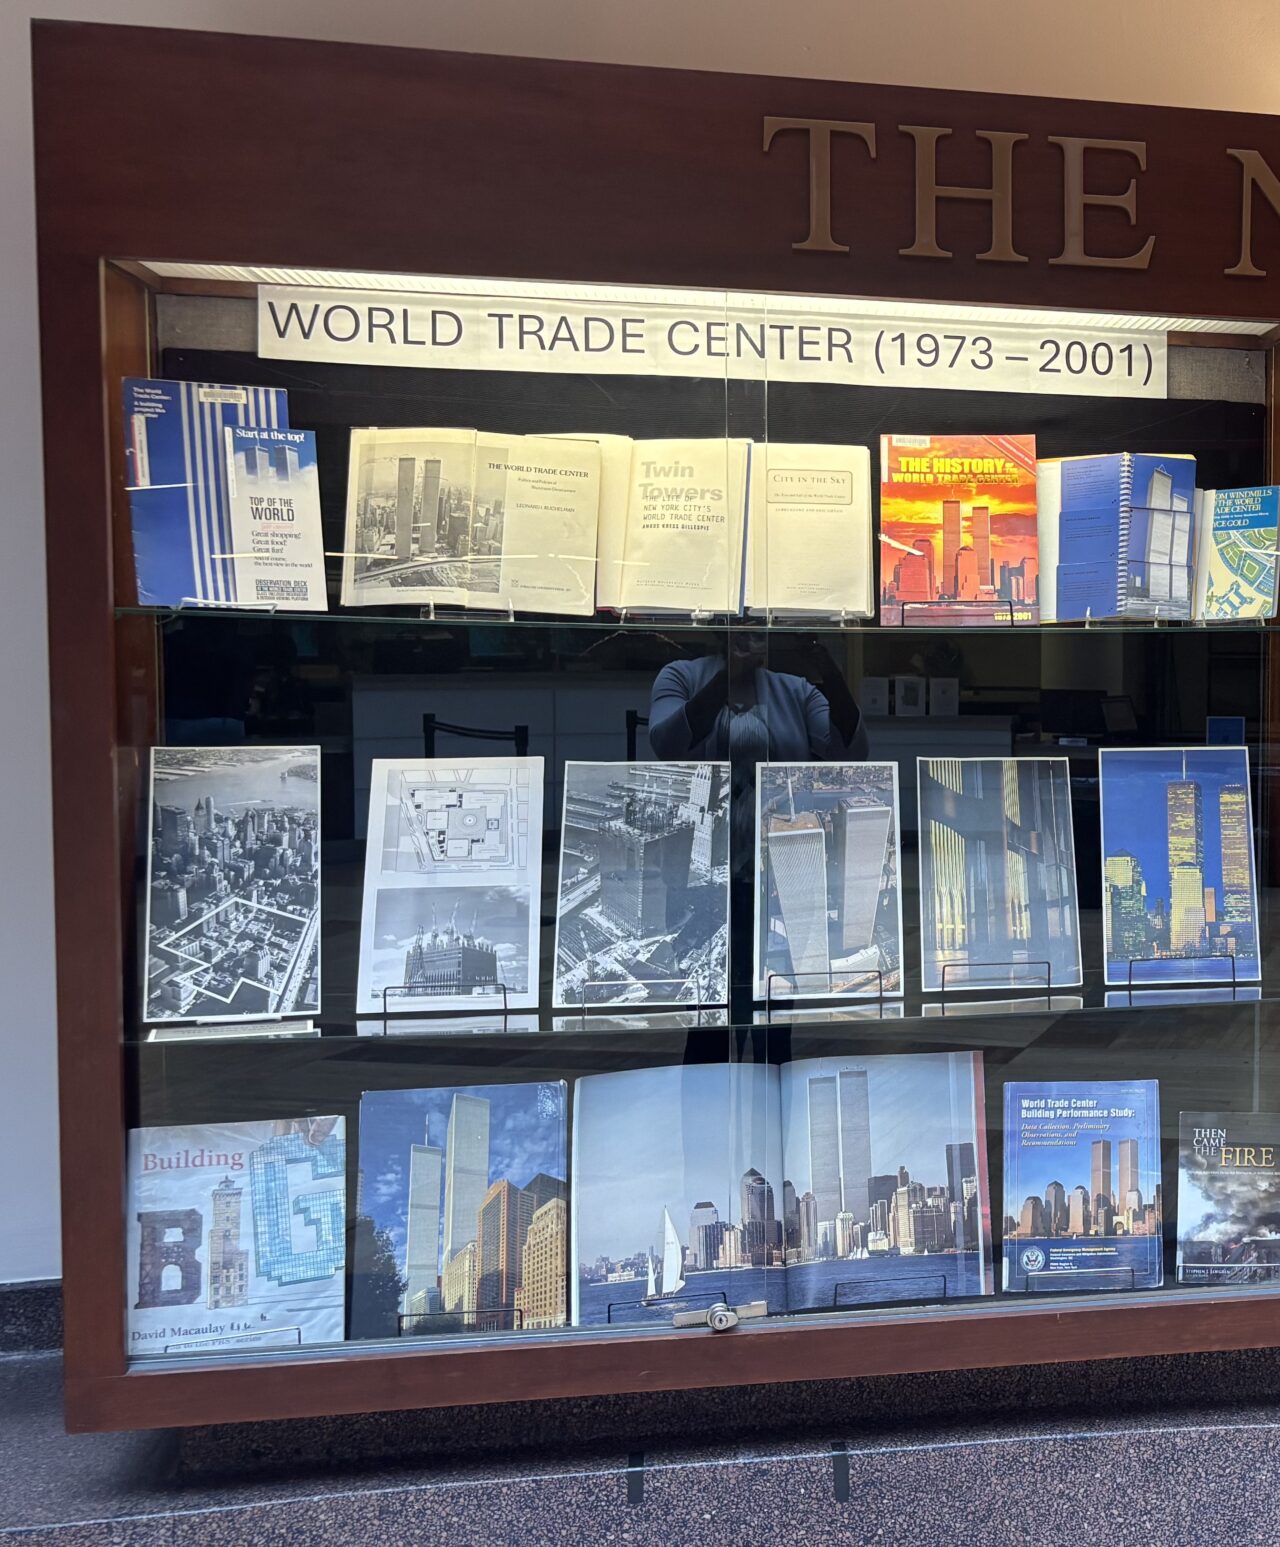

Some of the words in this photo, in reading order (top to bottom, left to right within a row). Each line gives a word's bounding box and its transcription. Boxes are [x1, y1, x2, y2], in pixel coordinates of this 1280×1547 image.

[763, 116, 1156, 271] THE
[267, 301, 463, 347] WORLD
[487, 313, 645, 354] TRADE
[667, 320, 853, 364] CENTER
[236, 428, 259, 438] Start
[260, 430, 269, 440] at
[270, 431, 286, 441] the
[287, 432, 305, 443] top!
[488, 462, 503, 470] THE
[504, 464, 532, 473] WORLD
[533, 467, 558, 476] TRADE
[559, 469, 589, 478] CENTER
[641, 460, 694, 478] Twin
[898, 456, 931, 472] THE
[933, 457, 1006, 474] HISTORY
[892, 472, 934, 483] WORLD
[937, 473, 974, 484] TRADE
[976, 474, 1019, 484] CENTER
[638, 482, 724, 501] Towers
[1229, 488, 1273, 498] WINDMILLS
[249, 496, 265, 507] TOP
[267, 497, 277, 507] OF
[278, 498, 294, 508] THE
[1234, 497, 1261, 506] WORLD
[250, 506, 295, 522] WORLD
[683, 505, 712, 513] CITY'S
[1231, 504, 1261, 513] CENTER
[643, 513, 666, 521] WORLD
[670, 513, 693, 521] TRADE
[696, 514, 726, 523] CENTER
[1227, 518, 1249, 526] GOLD
[251, 530, 269, 538] Great
[252, 538, 270, 546] Great
[255, 578, 292, 586] OBSERVATION
[1021, 1099, 1045, 1108] World
[1047, 1099, 1069, 1108] Trade
[1071, 1098, 1098, 1108] Center
[1021, 1109, 1055, 1119] Building
[1056, 1108, 1108, 1118] Performance
[1110, 1107, 1136, 1118] Study:
[1193, 1128, 1227, 1138] THEN
[1193, 1138, 1227, 1147] CAME
[1193, 1146, 1217, 1156] THE
[1219, 1147, 1276, 1167] FIRE
[143, 1149, 245, 1171] Building
[134, 1131, 346, 1310] BIG
[131, 1328, 166, 1341] David
[170, 1323, 226, 1338] Macaulay
